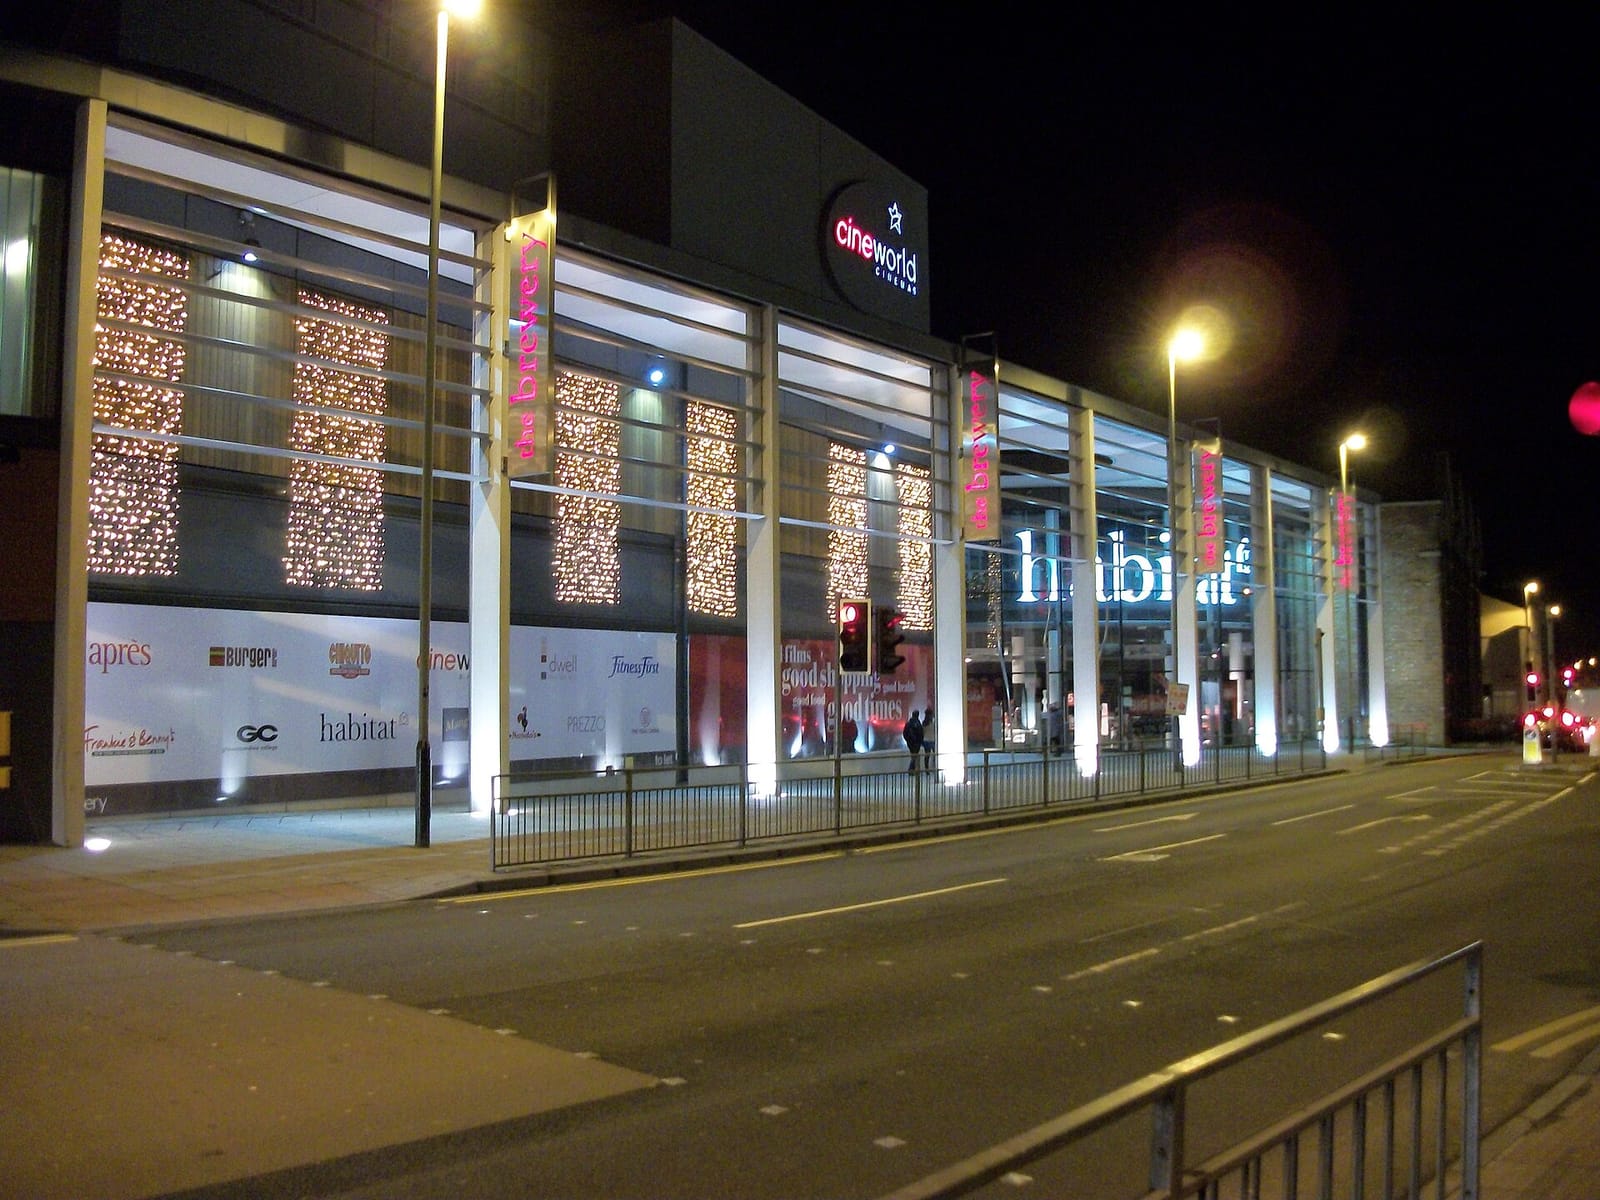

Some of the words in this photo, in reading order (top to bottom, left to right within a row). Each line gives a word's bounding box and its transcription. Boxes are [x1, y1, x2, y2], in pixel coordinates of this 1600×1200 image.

[836, 218, 917, 284] cineworld
[510, 231, 548, 405] brewery
[513, 412, 535, 459] the
[965, 369, 990, 492] brewery
[1015, 531, 1237, 605] hbiat
[88, 640, 151, 673] après
[549, 653, 577, 672] dwell
[785, 645, 812, 663] films
[782, 662, 818, 696] good
[820, 662, 881, 695] shpping
[84, 726, 125, 752] Frankie
[237, 724, 278, 742] GC
[320, 713, 397, 742] habitat
[567, 715, 606, 733] PREZZO
